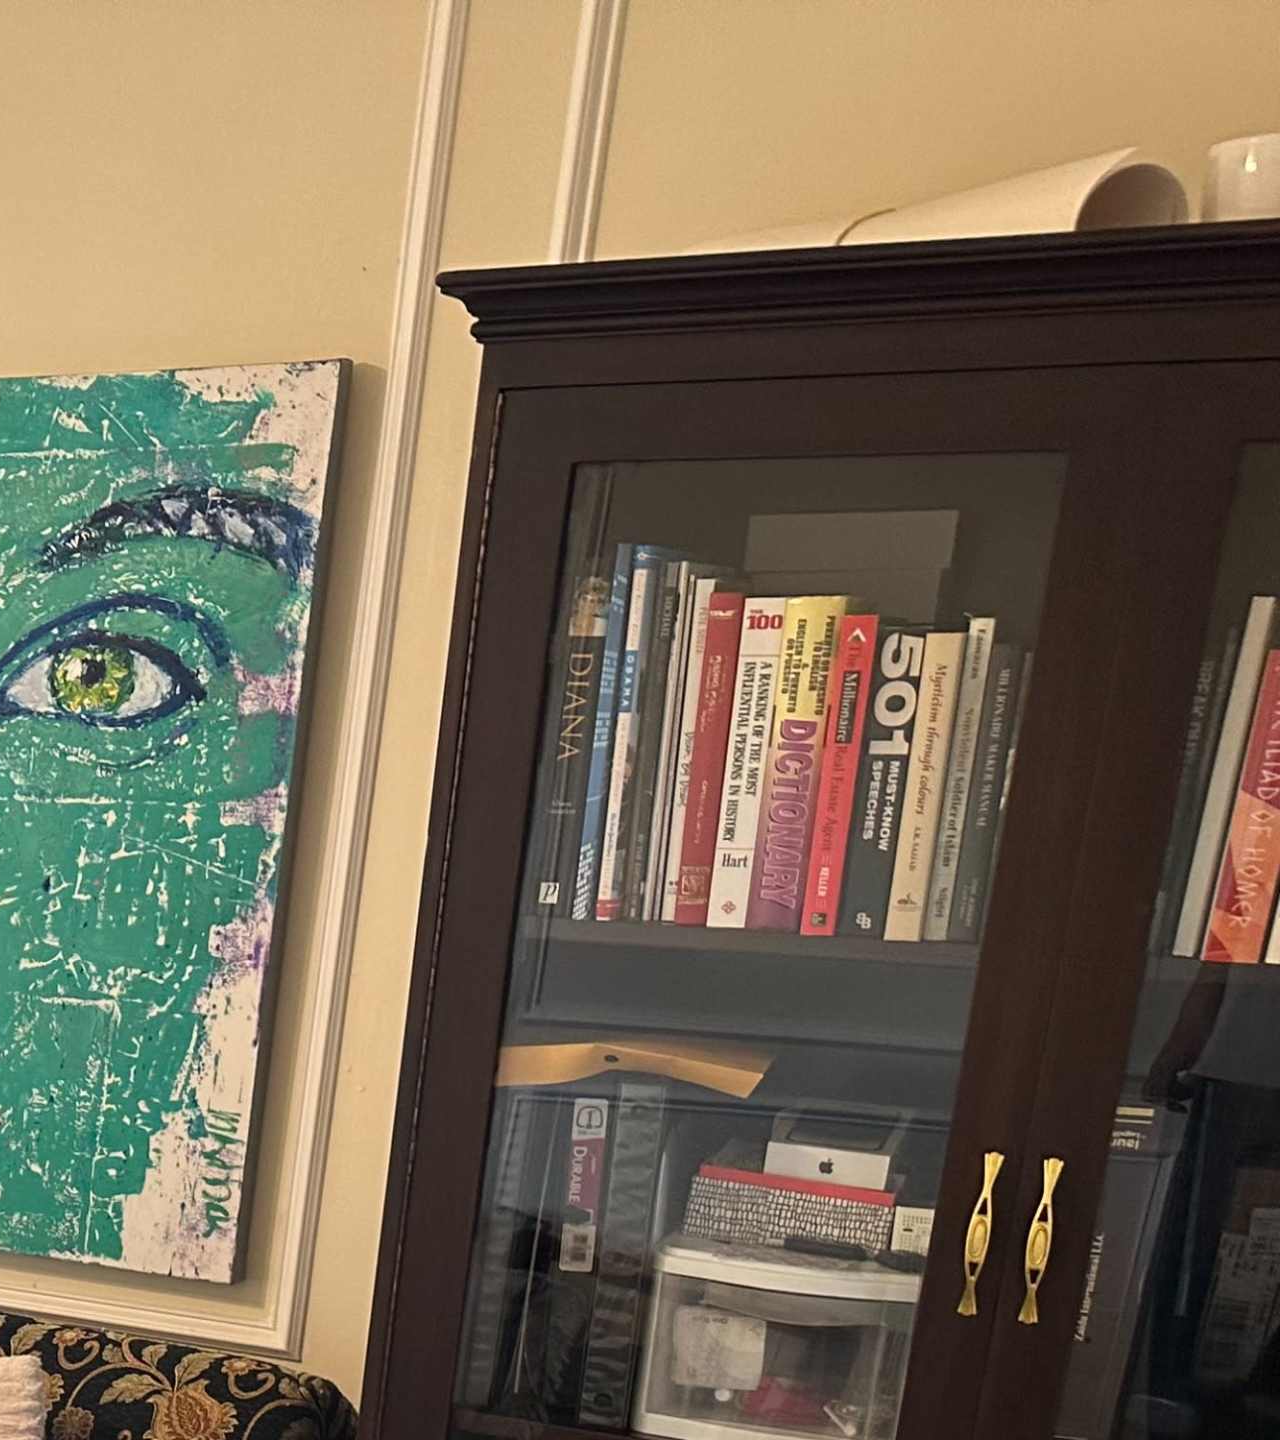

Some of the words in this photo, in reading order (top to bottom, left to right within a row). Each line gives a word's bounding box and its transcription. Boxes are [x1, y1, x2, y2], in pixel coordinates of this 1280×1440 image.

[746, 613, 784, 630] 100
[794, 618, 808, 655] ENGLISH
[620, 654, 636, 707] OBAMA
[760, 660, 773, 670] A
[808, 654, 821, 691] ENGLISH
[556, 653, 594, 761] DIANA
[738, 661, 757, 731] INFLUENTIAL
[753, 671, 772, 722] RANKING
[836, 671, 859, 742] Millionaire
[867, 631, 925, 756] 501
[748, 741, 763, 764] THE
[751, 724, 766, 740] OF
[918, 726, 941, 772] through
[730, 732, 749, 780] PERSONS
[831, 745, 849, 774] Real
[727, 784, 741, 796] IN
[744, 765, 761, 797] MOST
[826, 776, 844, 813] Estate
[862, 760, 885, 841] SPEECHES
[915, 774, 931, 816] colours
[948, 775, 965, 818] Soldier
[722, 800, 739, 842] HISTORY
[759, 719, 819, 910] DICTIONARY
[878, 760, 902, 851] MUST-KNOW
[1247, 808, 1276, 838] OF
[822, 817, 839, 851] Agent
[942, 834, 957, 868] Islam
[721, 853, 748, 868] Hart
[817, 866, 831, 897] KELLER
[1228, 847, 1266, 929] HOMER
[568, 1145, 588, 1204] DURABLE
